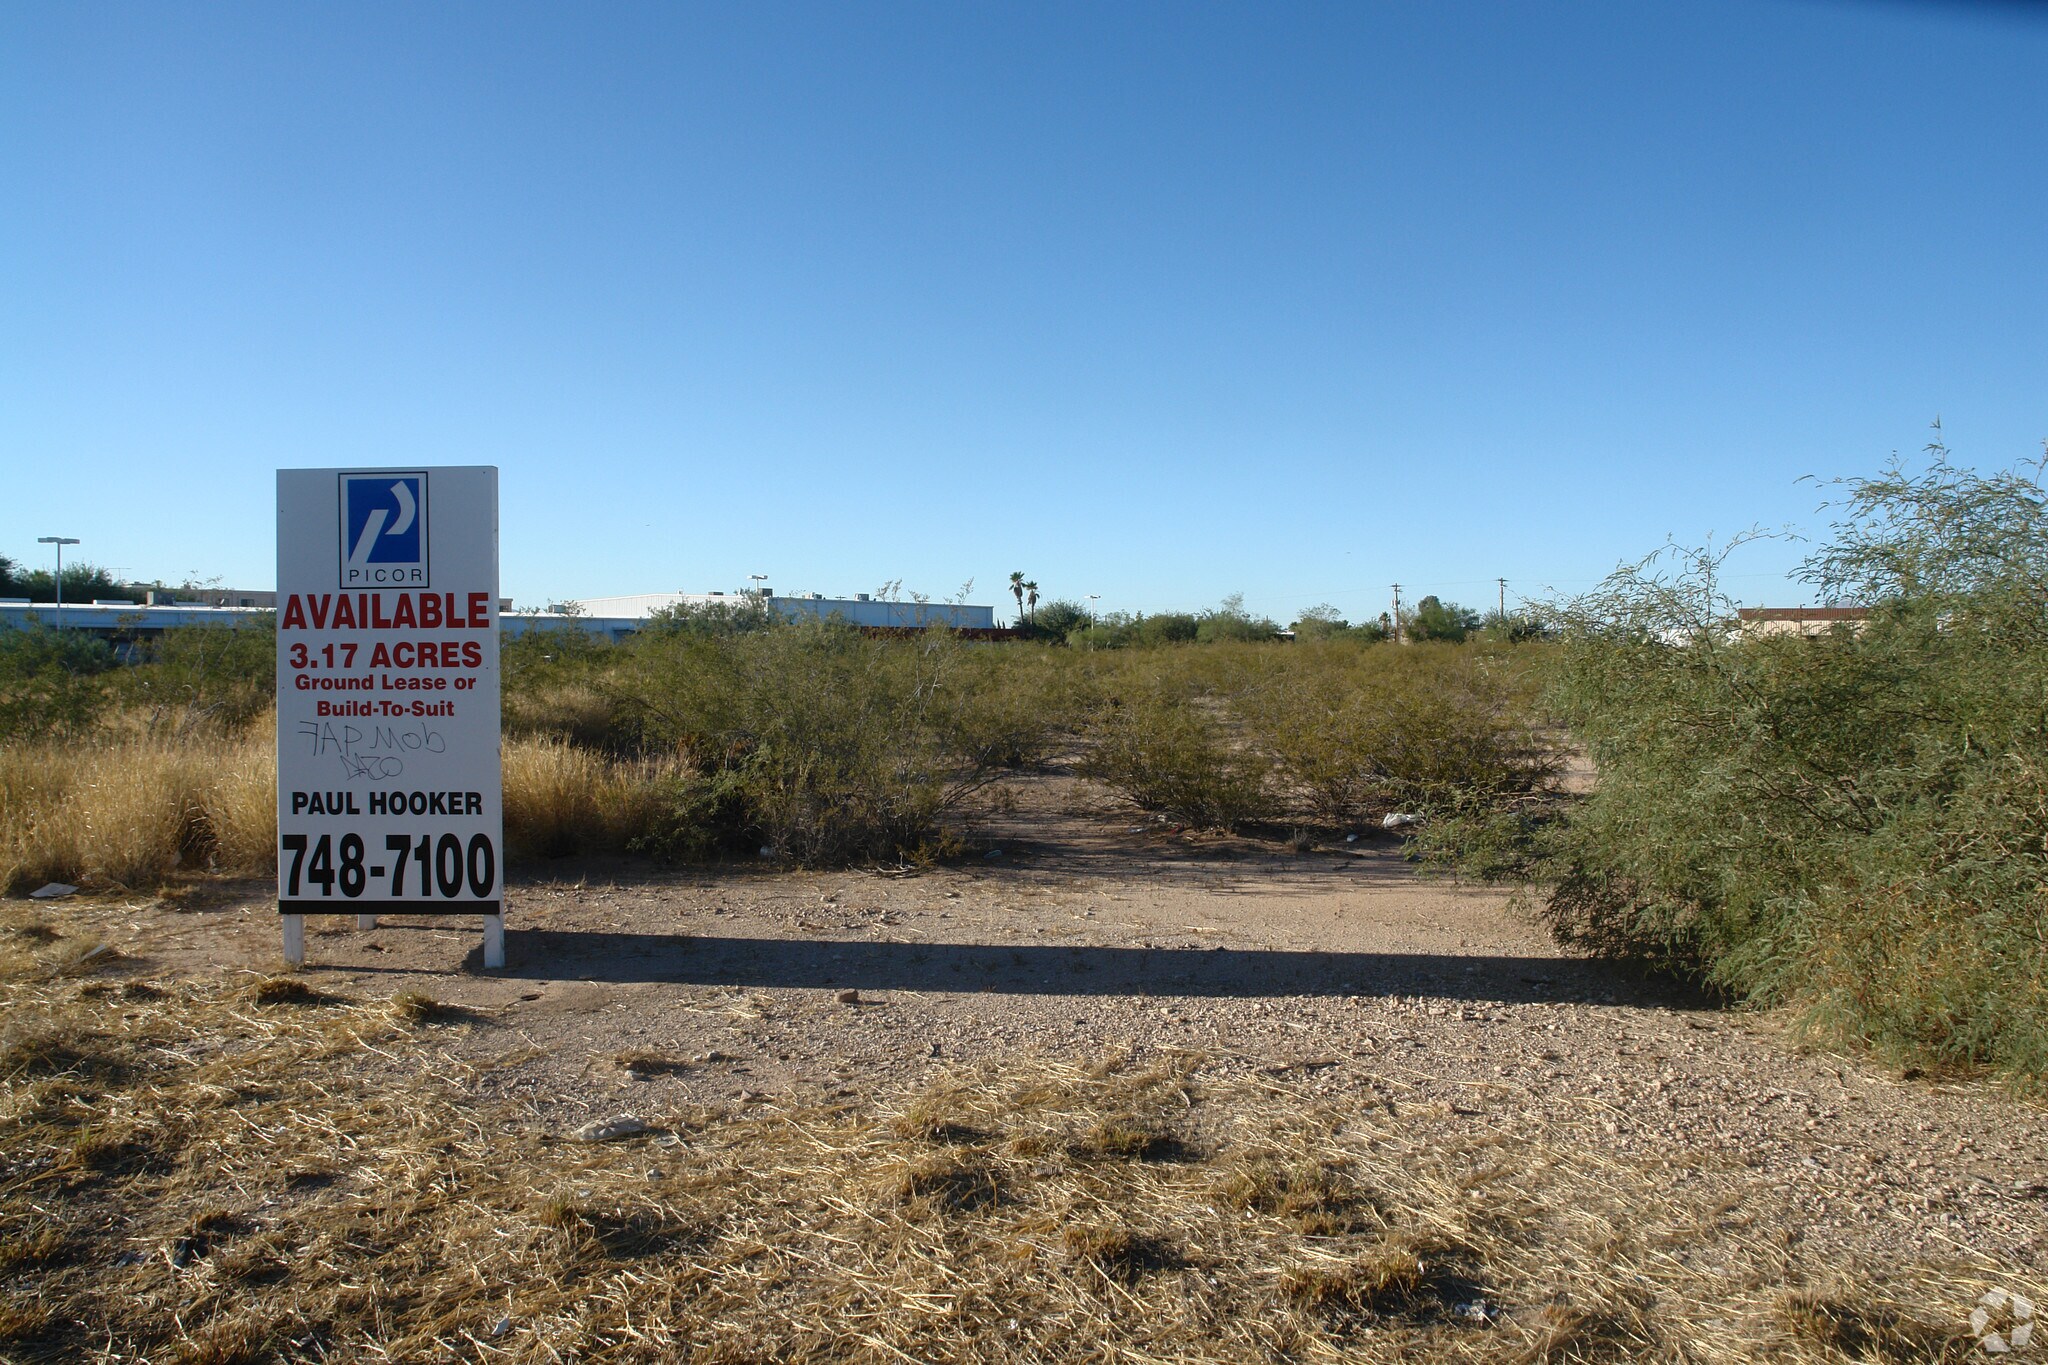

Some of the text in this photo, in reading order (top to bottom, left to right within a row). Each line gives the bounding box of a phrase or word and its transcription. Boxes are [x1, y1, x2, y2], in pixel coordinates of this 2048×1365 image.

[349, 568, 423, 582] PICOR
[281, 592, 490, 630] AVAILABLE
[289, 641, 482, 669] 3.17 ACRES
[295, 674, 477, 691] Ground Lease or
[316, 700, 455, 717] Build-To-Suit
[292, 792, 483, 815] PAUL HOOKER
[282, 833, 495, 899] 748-7100
